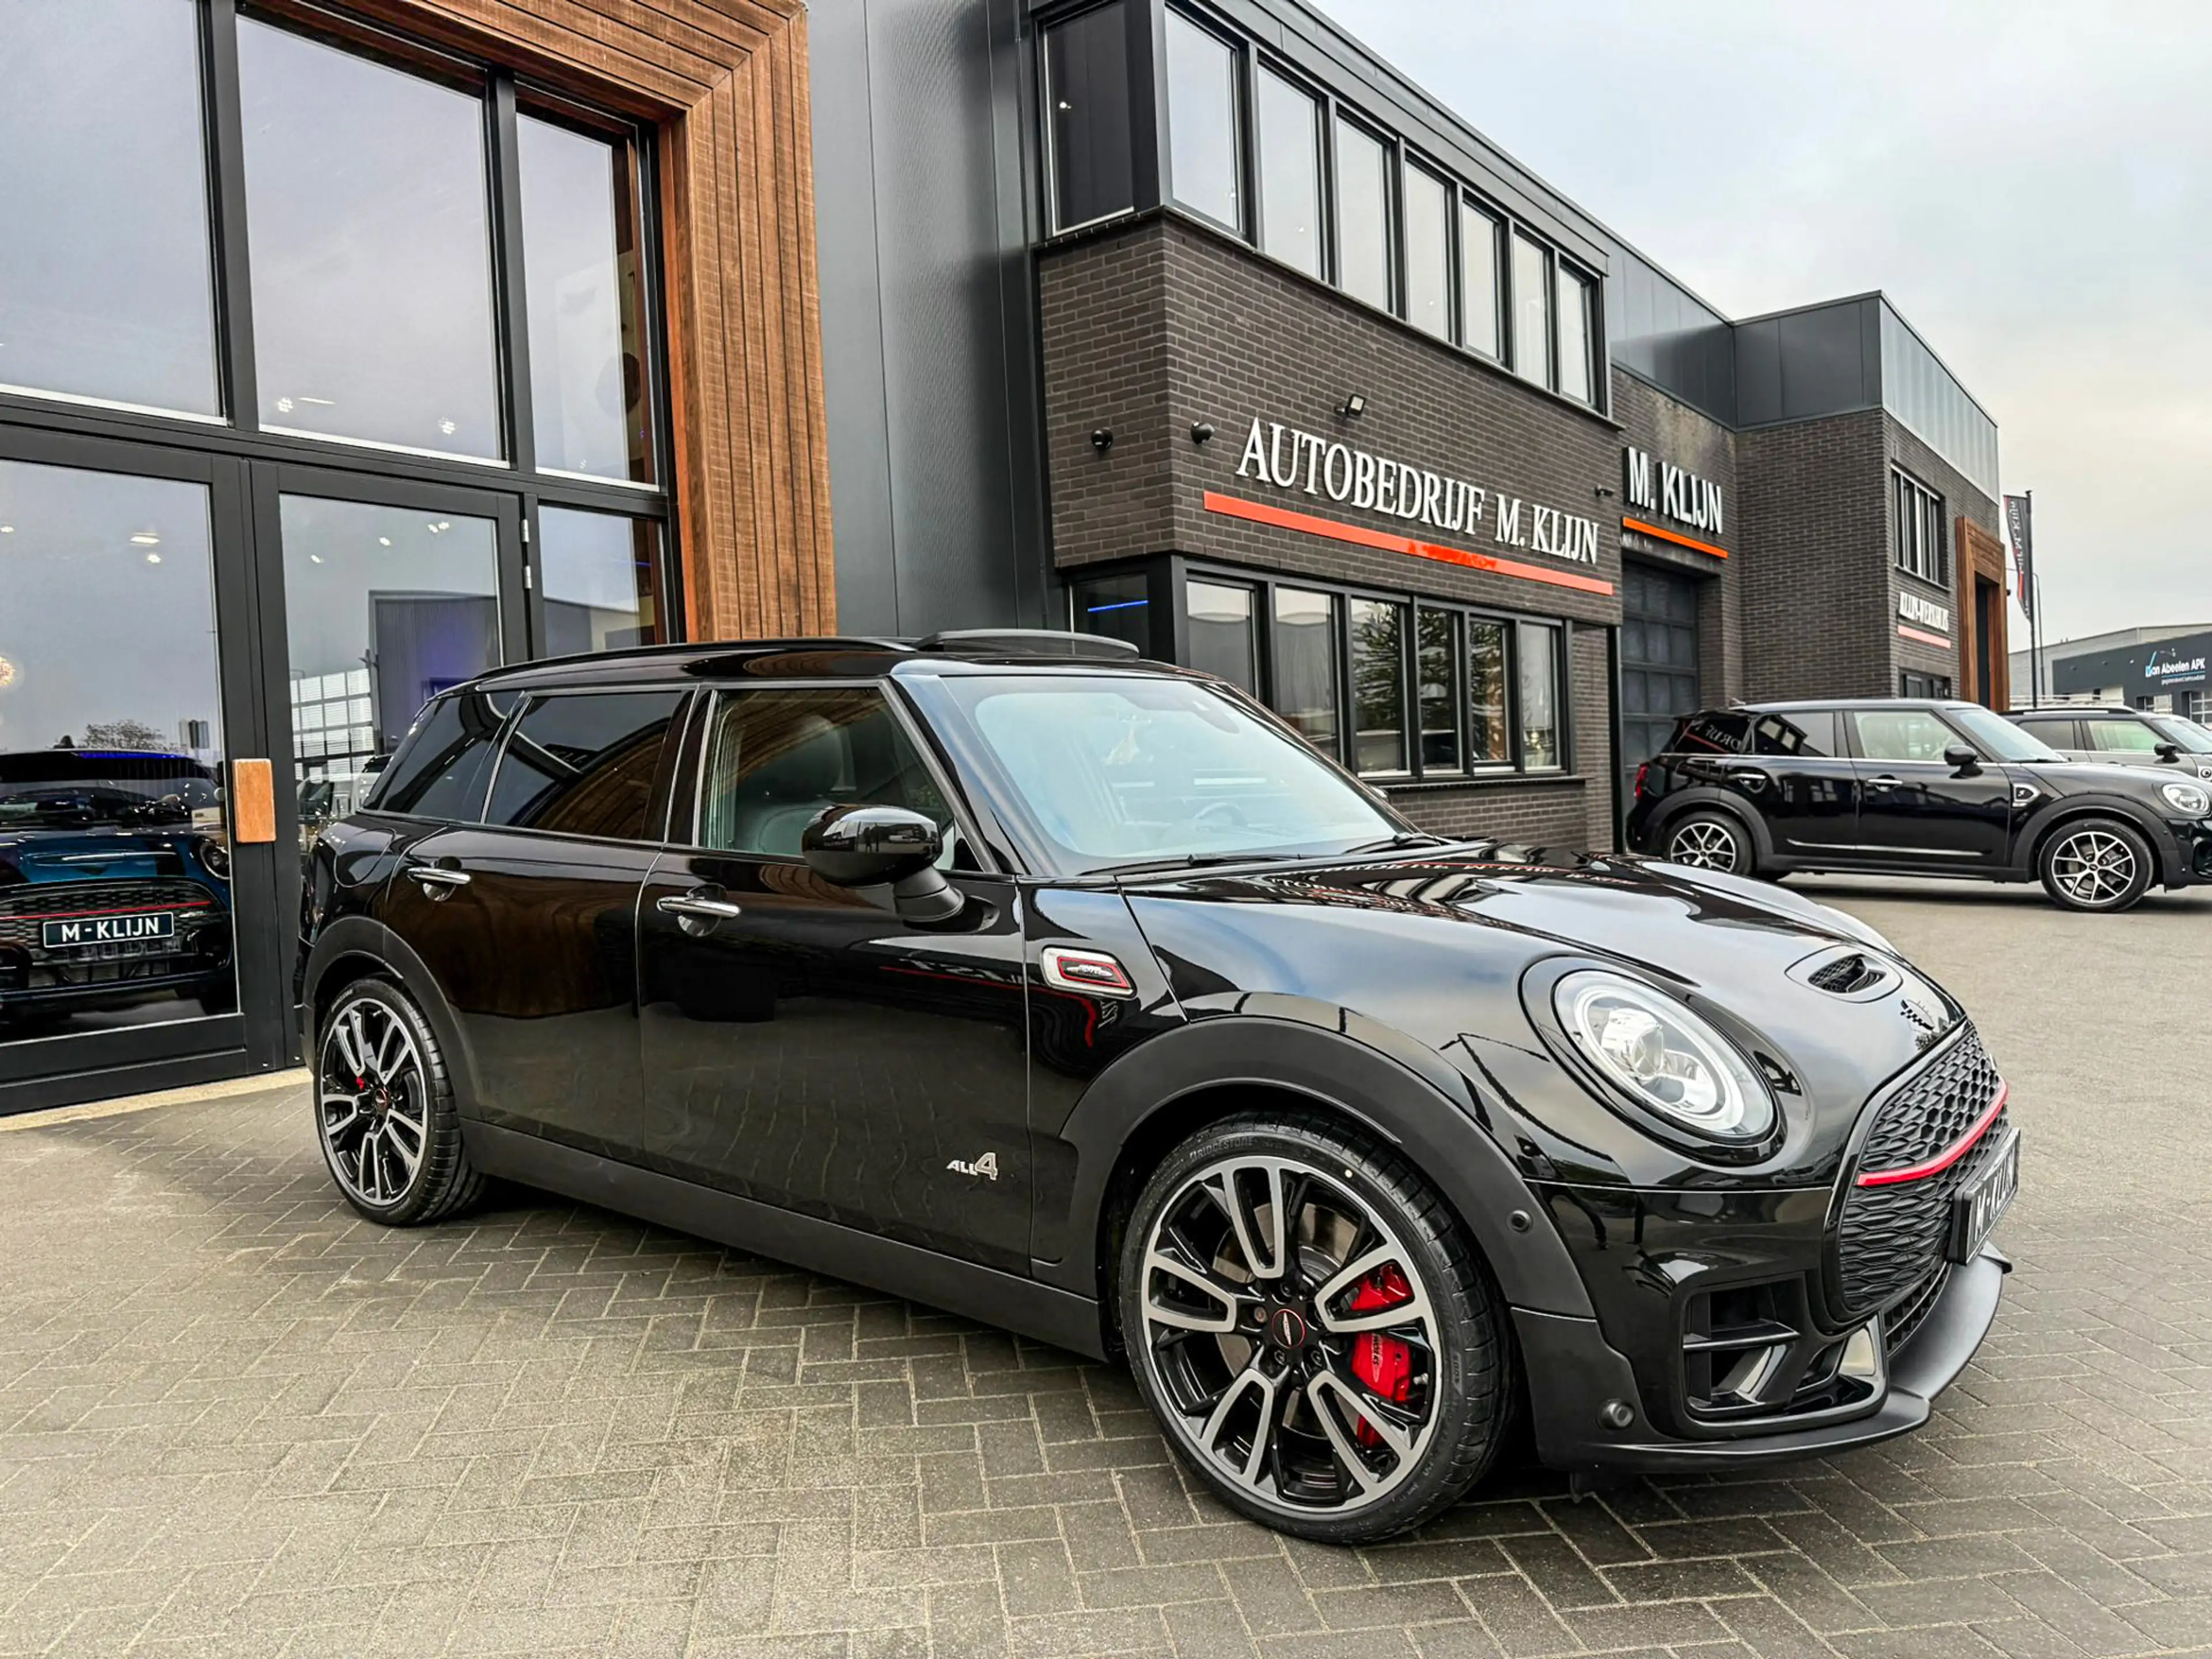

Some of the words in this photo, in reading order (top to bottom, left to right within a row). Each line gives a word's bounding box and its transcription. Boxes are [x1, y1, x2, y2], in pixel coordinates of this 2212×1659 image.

[1236, 417, 1486, 536] AUTOBEDRIJF
[1495, 493, 1526, 548] M.
[1531, 503, 1599, 565] KLIJN
[1626, 445, 1656, 510] M.
[1658, 461, 1722, 535] KLIJN
[2191, 657, 2206, 671] APK
